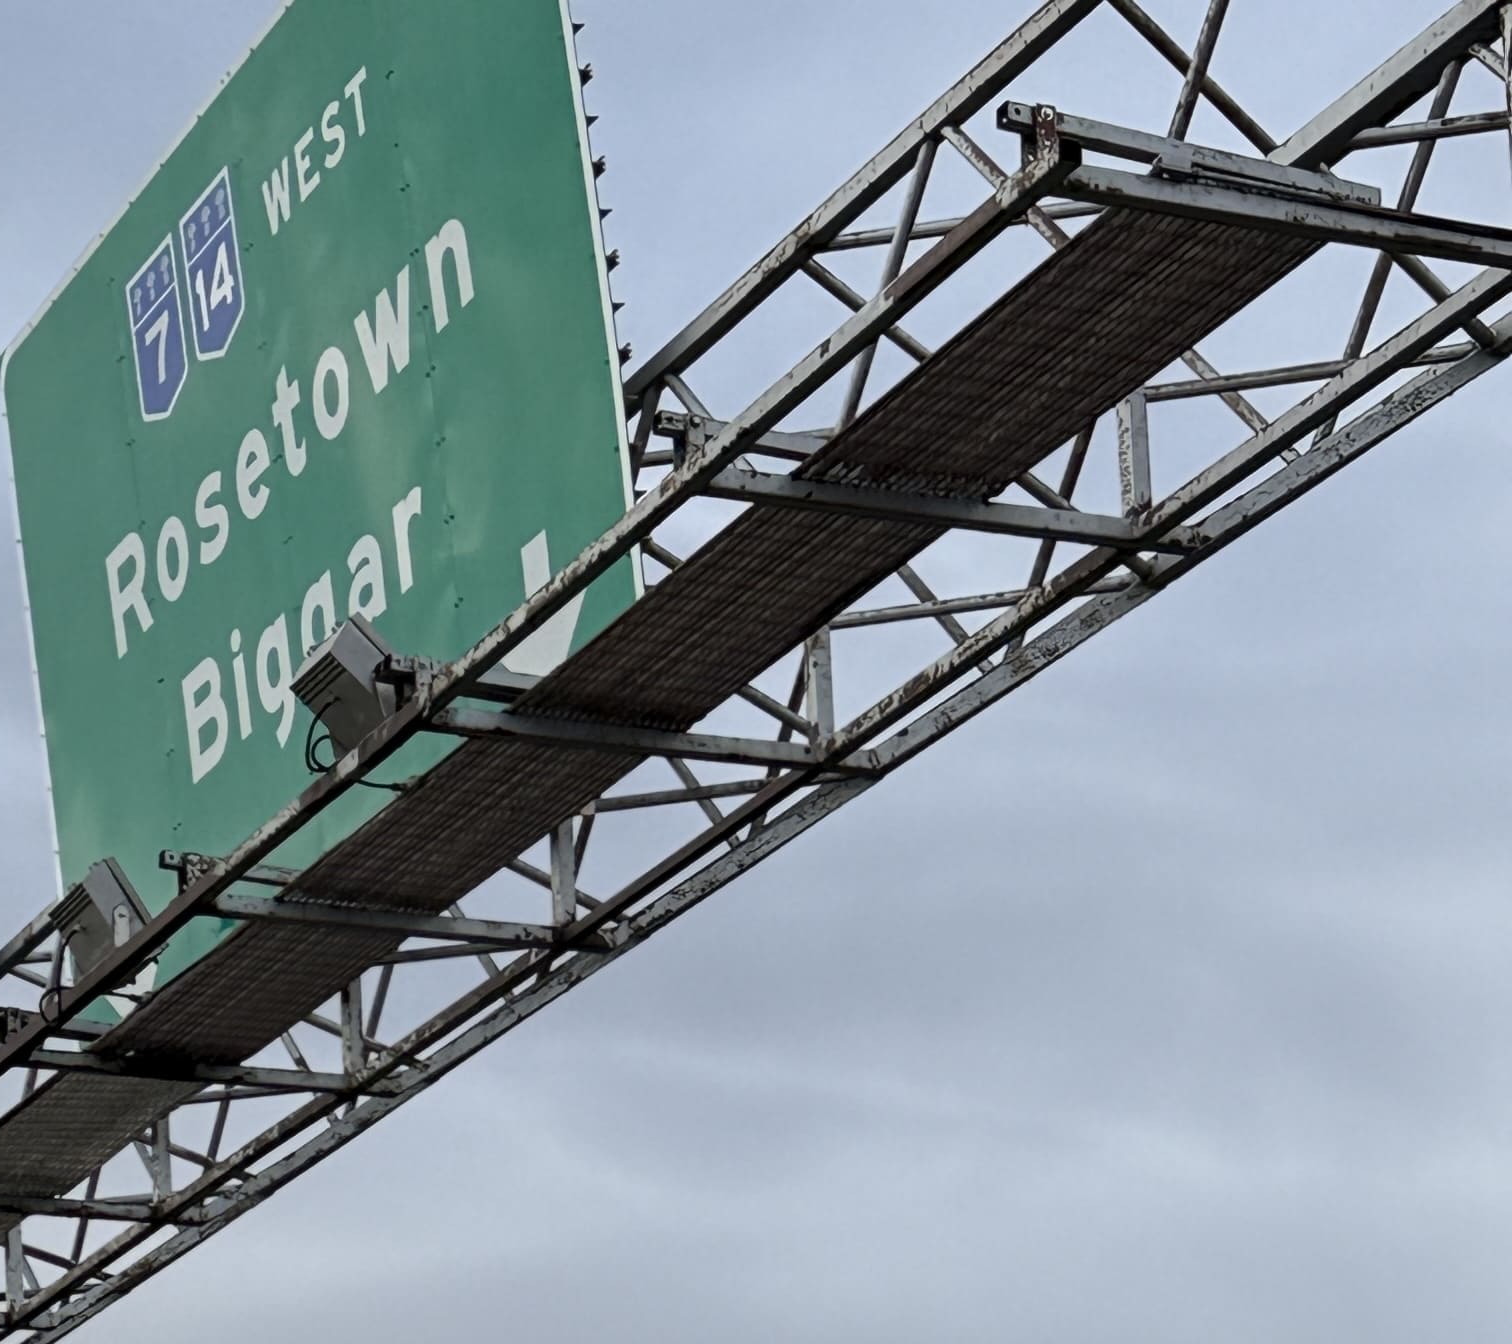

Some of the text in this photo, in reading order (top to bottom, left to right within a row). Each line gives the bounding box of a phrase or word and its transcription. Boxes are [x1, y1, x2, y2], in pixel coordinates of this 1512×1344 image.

[144, 66, 368, 385] 7 14 WEST
[105, 218, 476, 659] Rosetown
